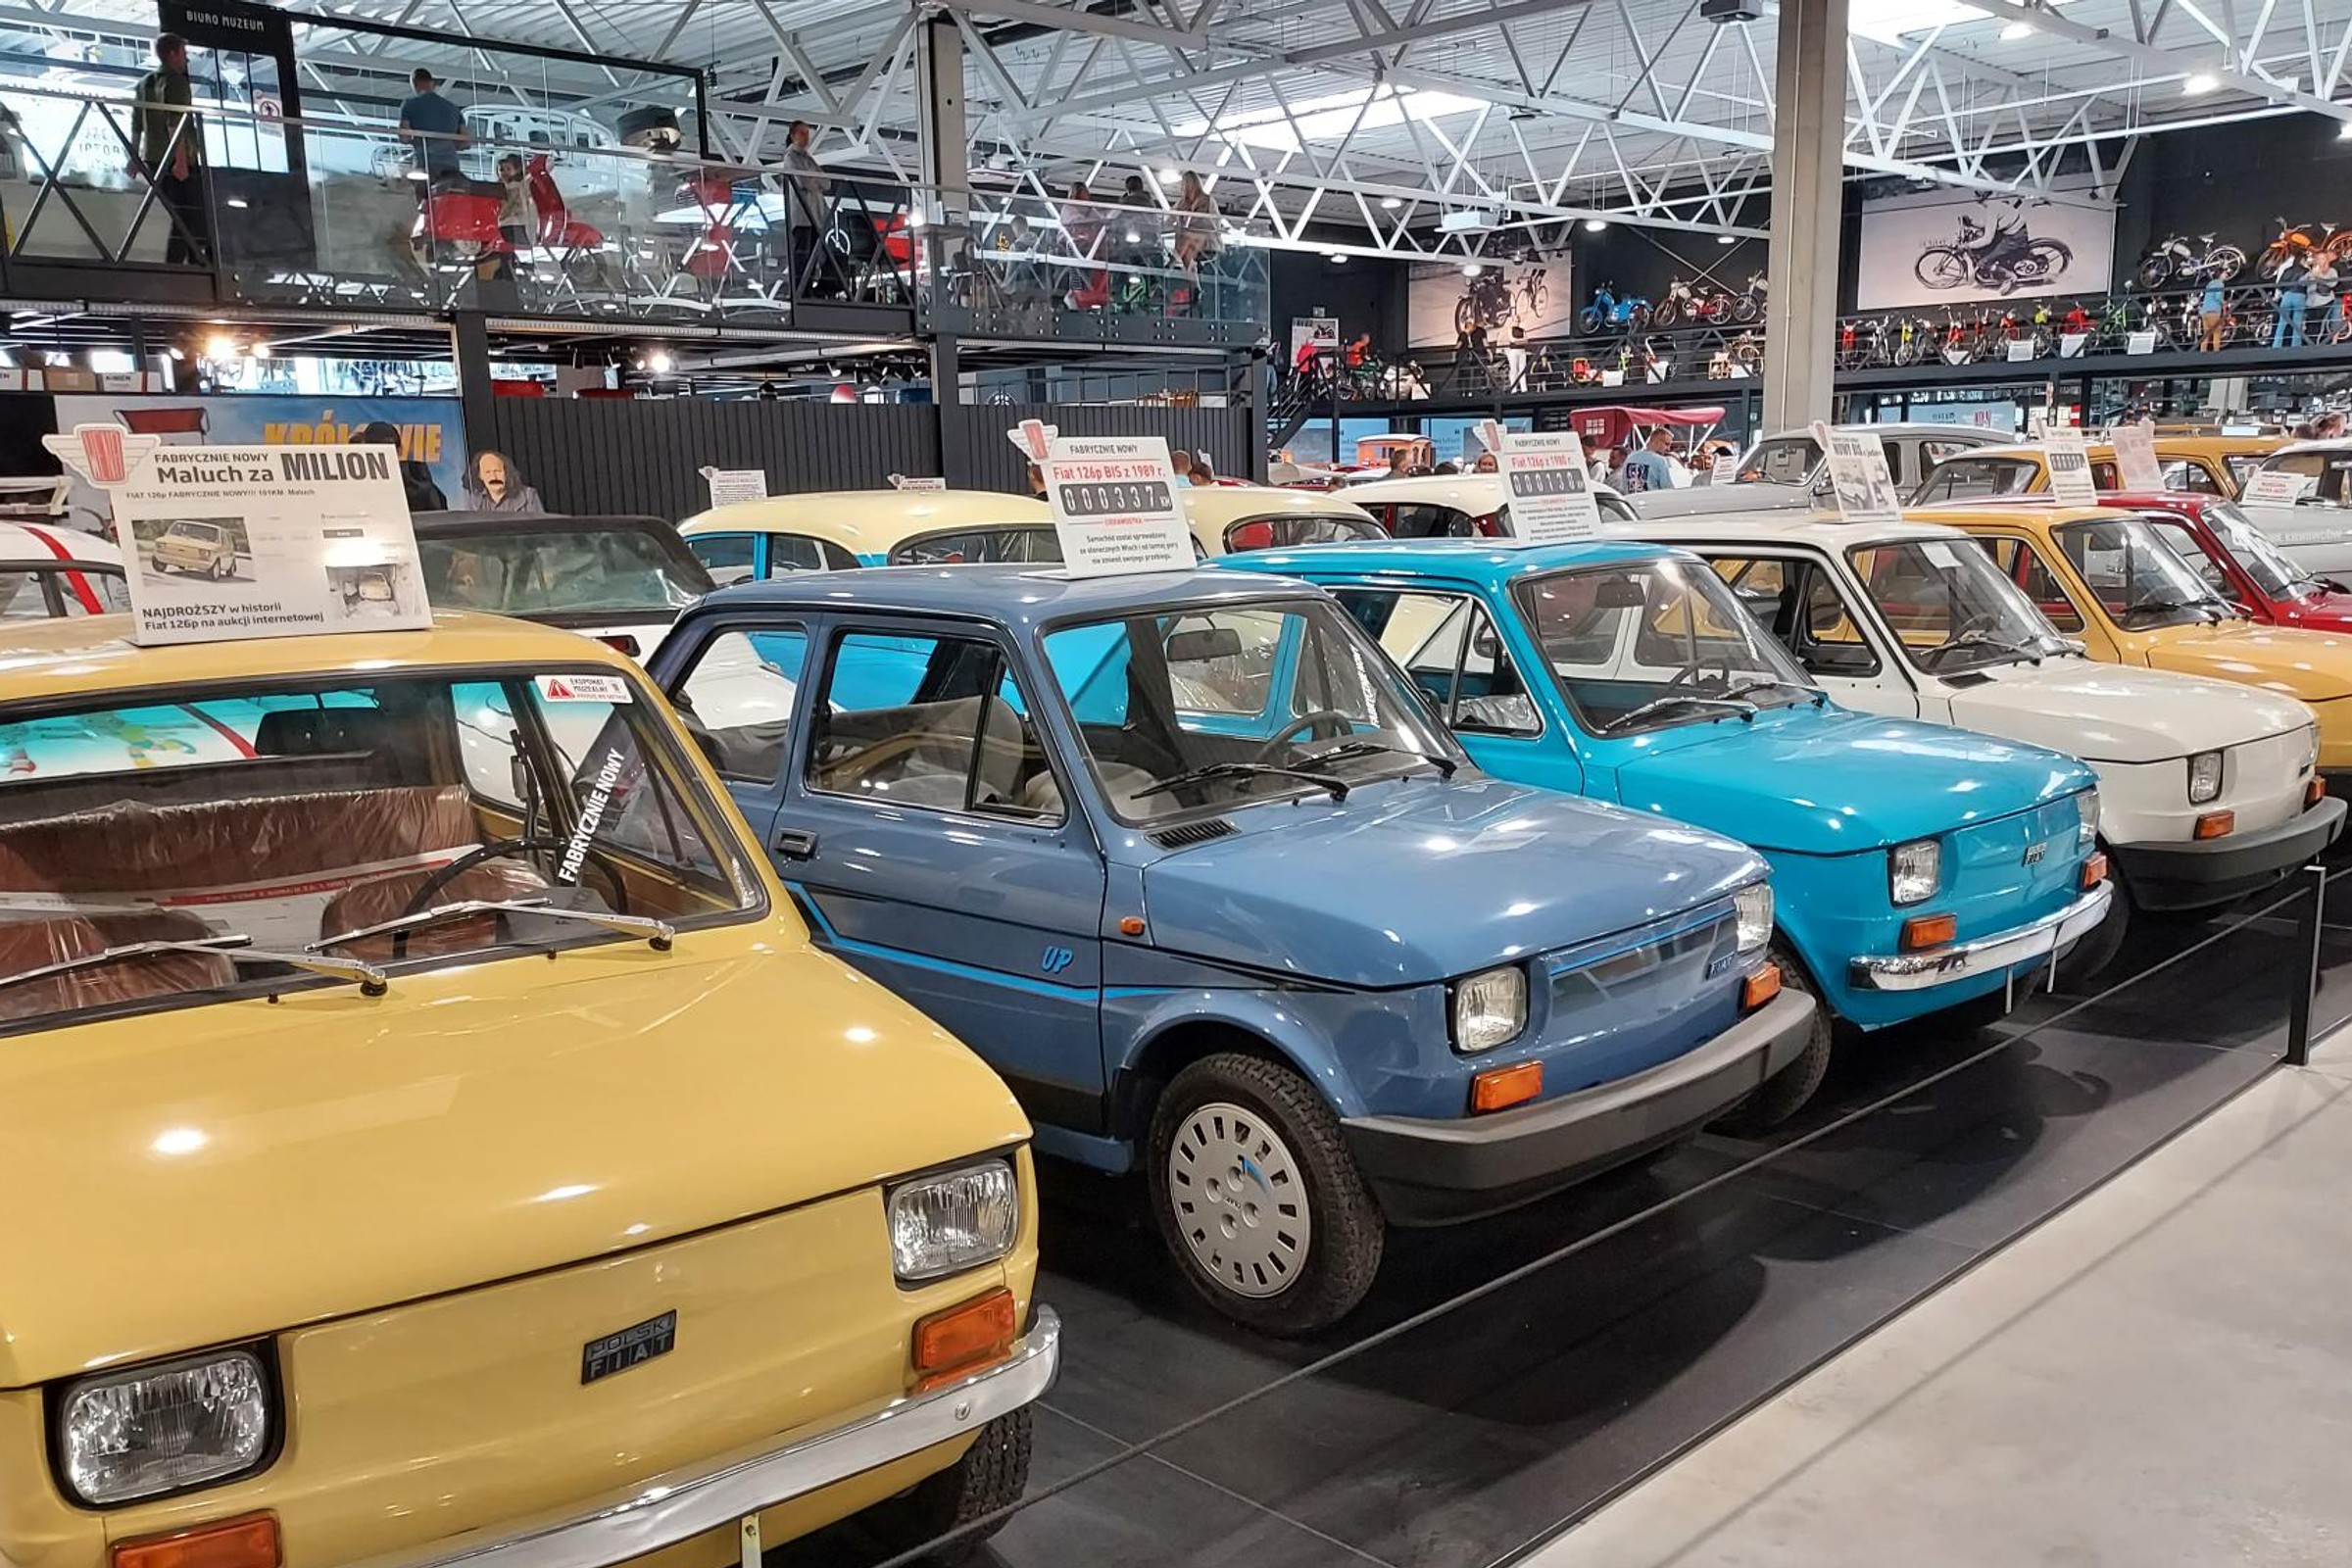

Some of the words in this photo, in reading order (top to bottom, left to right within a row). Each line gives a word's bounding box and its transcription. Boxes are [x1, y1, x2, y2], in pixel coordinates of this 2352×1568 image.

[186, 11, 219, 25] BIURO
[221, 15, 265, 31] MUZEUM
[154, 453, 230, 464] FABRYCZNIE
[232, 453, 270, 463] NOWY
[1070, 444, 1115, 455] FABRYCZNIE
[1117, 444, 1138, 454] NOWY
[157, 466, 244, 483] Maluch
[248, 467, 274, 482] za
[280, 452, 391, 481] MILION
[1512, 457, 1526, 468] Fiat
[1527, 456, 1544, 469] 126p
[1053, 466, 1075, 479] Fiat
[1077, 466, 1102, 480] 126p
[1103, 466, 1123, 478] BIS
[1125, 467, 1131, 477] z
[1133, 465, 1155, 477] 1989
[1157, 466, 1166, 476] r.
[126, 491, 145, 500] FIAT
[169, 490, 220, 499] FABRYCZNIE
[1064, 486, 1154, 511] 000337
[142, 603, 226, 618] NAJDROŻSZY
[241, 602, 282, 612] historii
[145, 619, 168, 630] Fiat
[170, 619, 199, 630] 126p
[218, 615, 251, 627] aukcji
[253, 612, 324, 625] internetowej
[558, 790, 610, 882] FABRYCZNIE
[595, 747, 625, 793] NOWY
[1042, 946, 1074, 974] UP
[588, 1315, 673, 1358] POLSKI
[590, 1333, 671, 1378] FIAT
